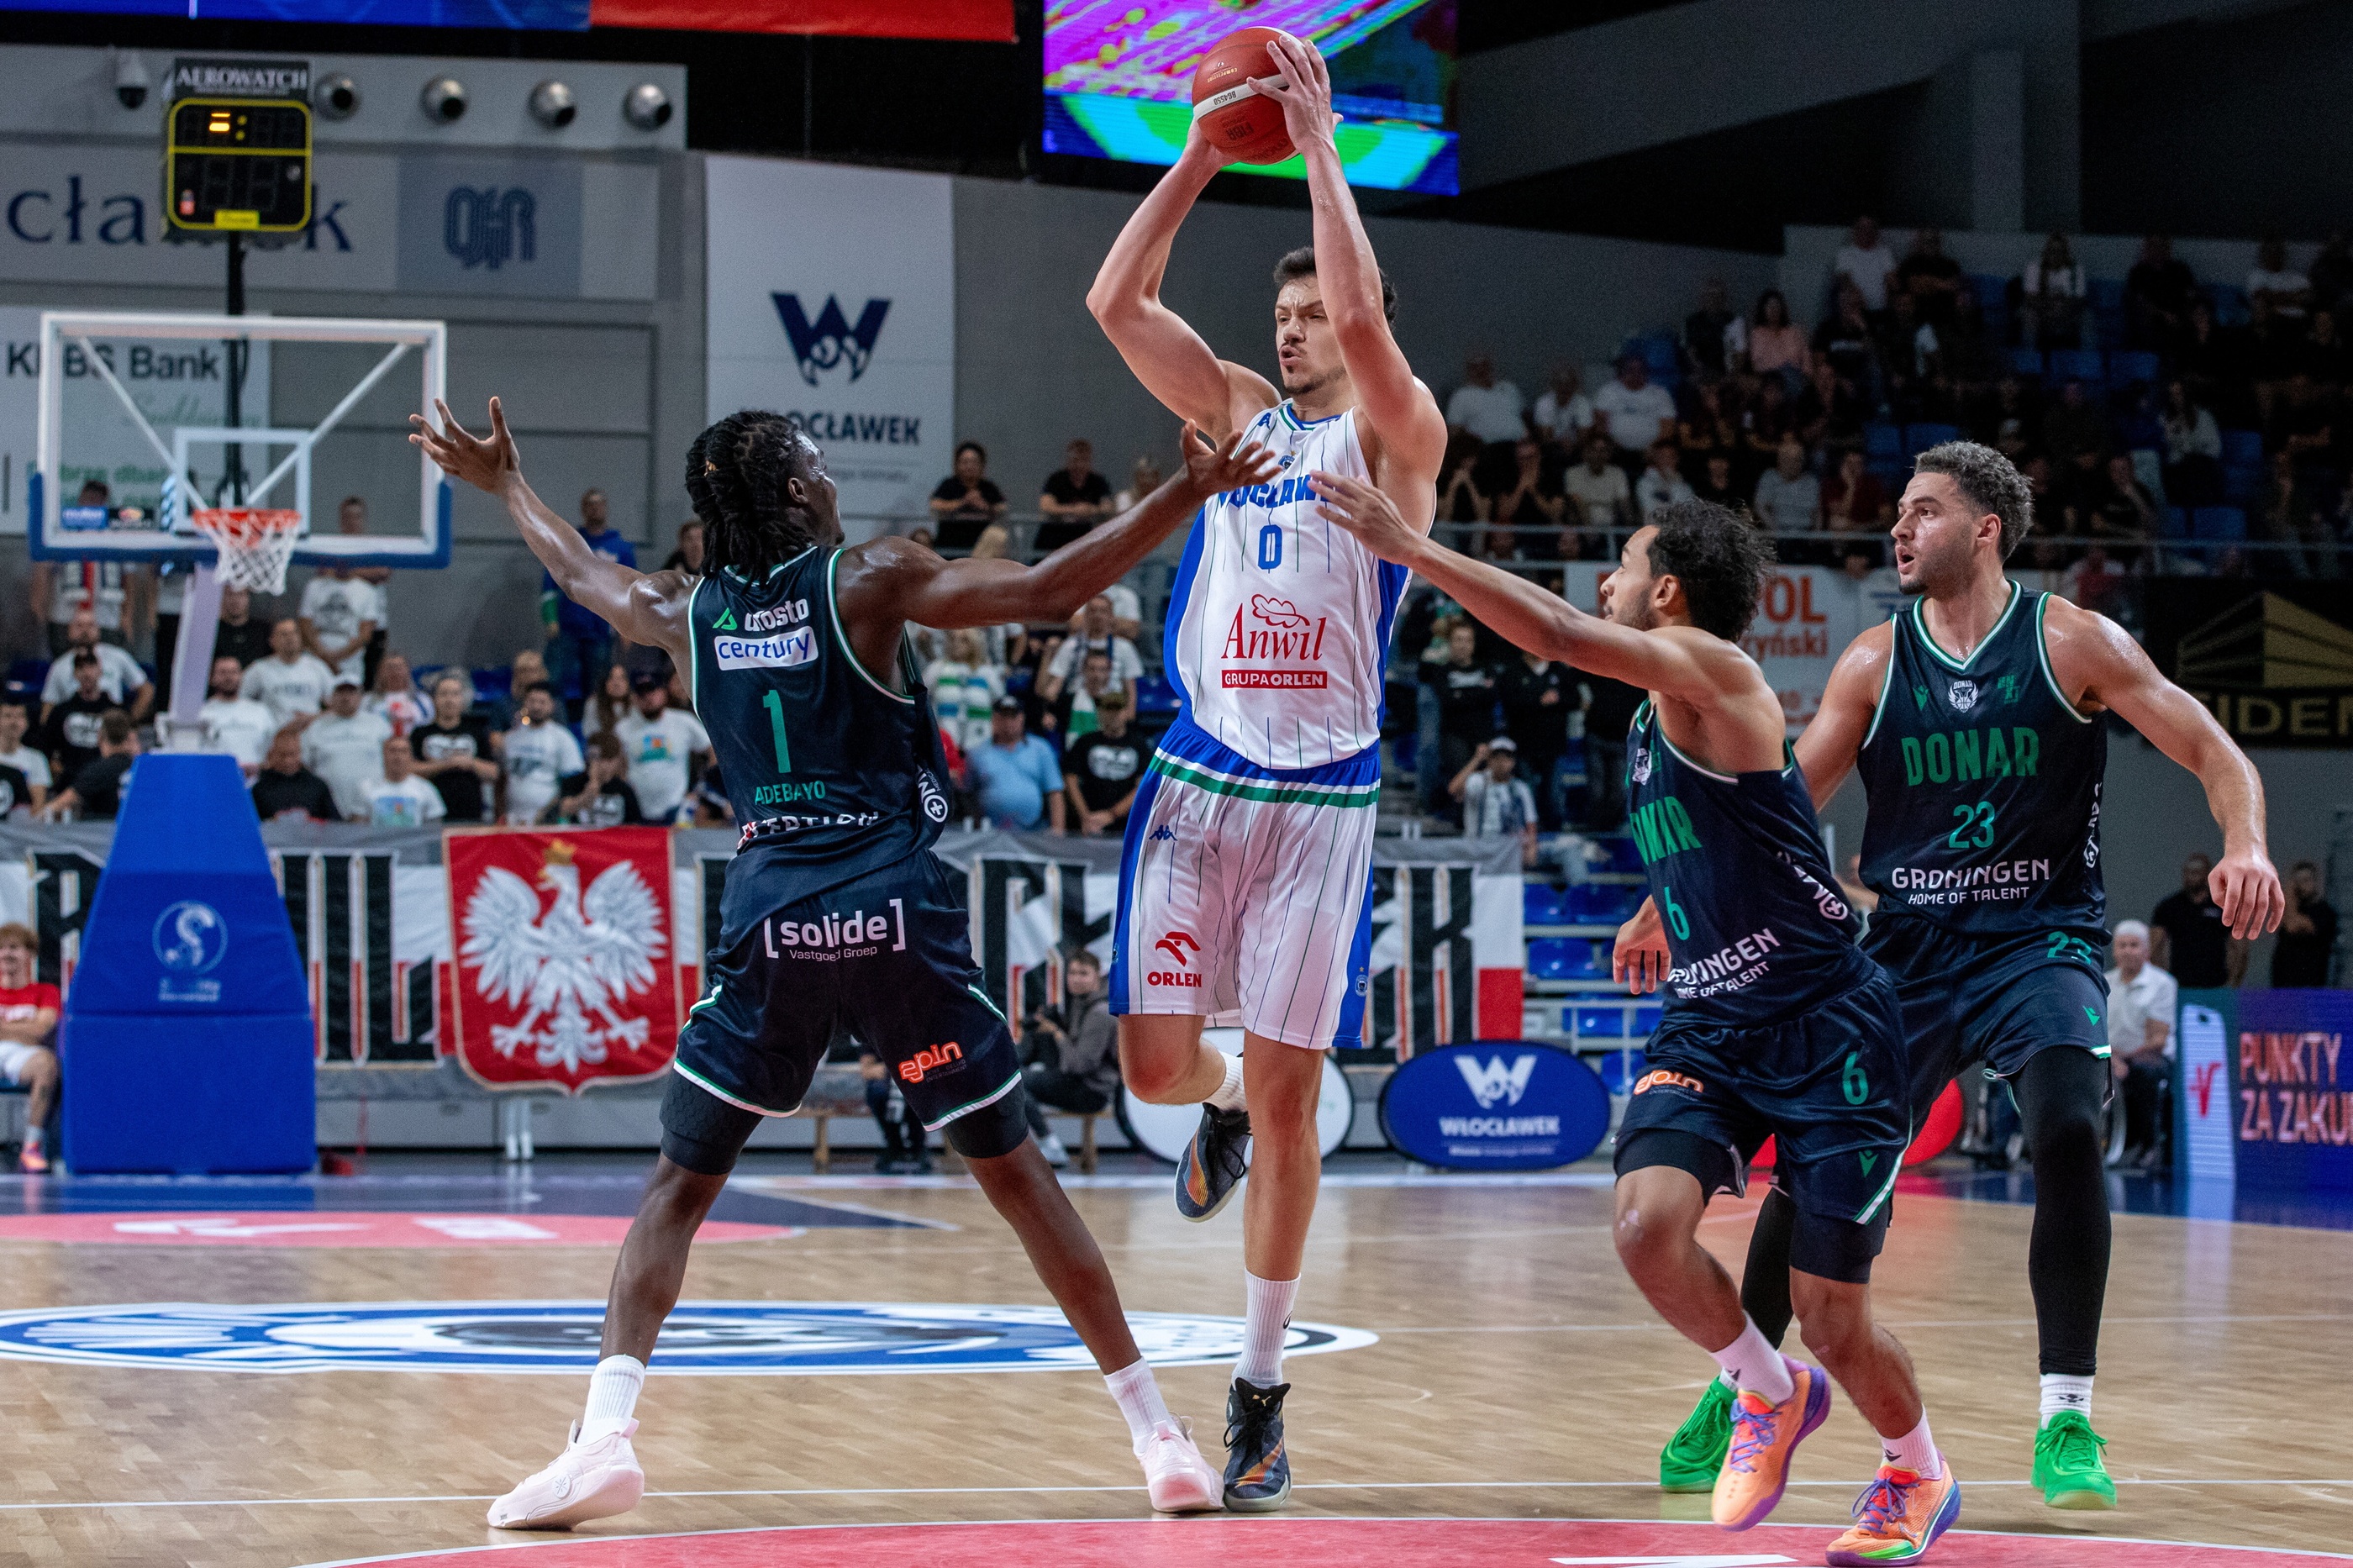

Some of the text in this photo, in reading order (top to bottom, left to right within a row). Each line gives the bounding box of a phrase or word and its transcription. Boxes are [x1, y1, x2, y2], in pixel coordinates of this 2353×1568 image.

[176, 66, 308, 90] AEROWATCH
[1213, 90, 1237, 106] BG4550
[131, 346, 218, 381] Bank
[1257, 524, 1283, 570] 0
[719, 633, 809, 660] century
[1220, 602, 1327, 661] Anwil
[1953, 680, 1973, 690] DONAR
[762, 689, 792, 774] 1
[1901, 726, 2040, 787] DONAR
[755, 780, 825, 805] ADEBAYO
[1948, 801, 1996, 849] 23
[1891, 858, 2050, 889] GRONINGEN
[1664, 887, 1690, 940] 6
[1908, 887, 2029, 905] HOME OF TALENT
[844, 946, 878, 962] Groep
[1147, 971, 1203, 988] ORLEN
[2240, 1032, 2343, 1085] PUNKTY
[1841, 1050, 1870, 1106] 6
[2240, 1089, 2353, 1145] ZA ZAKU
